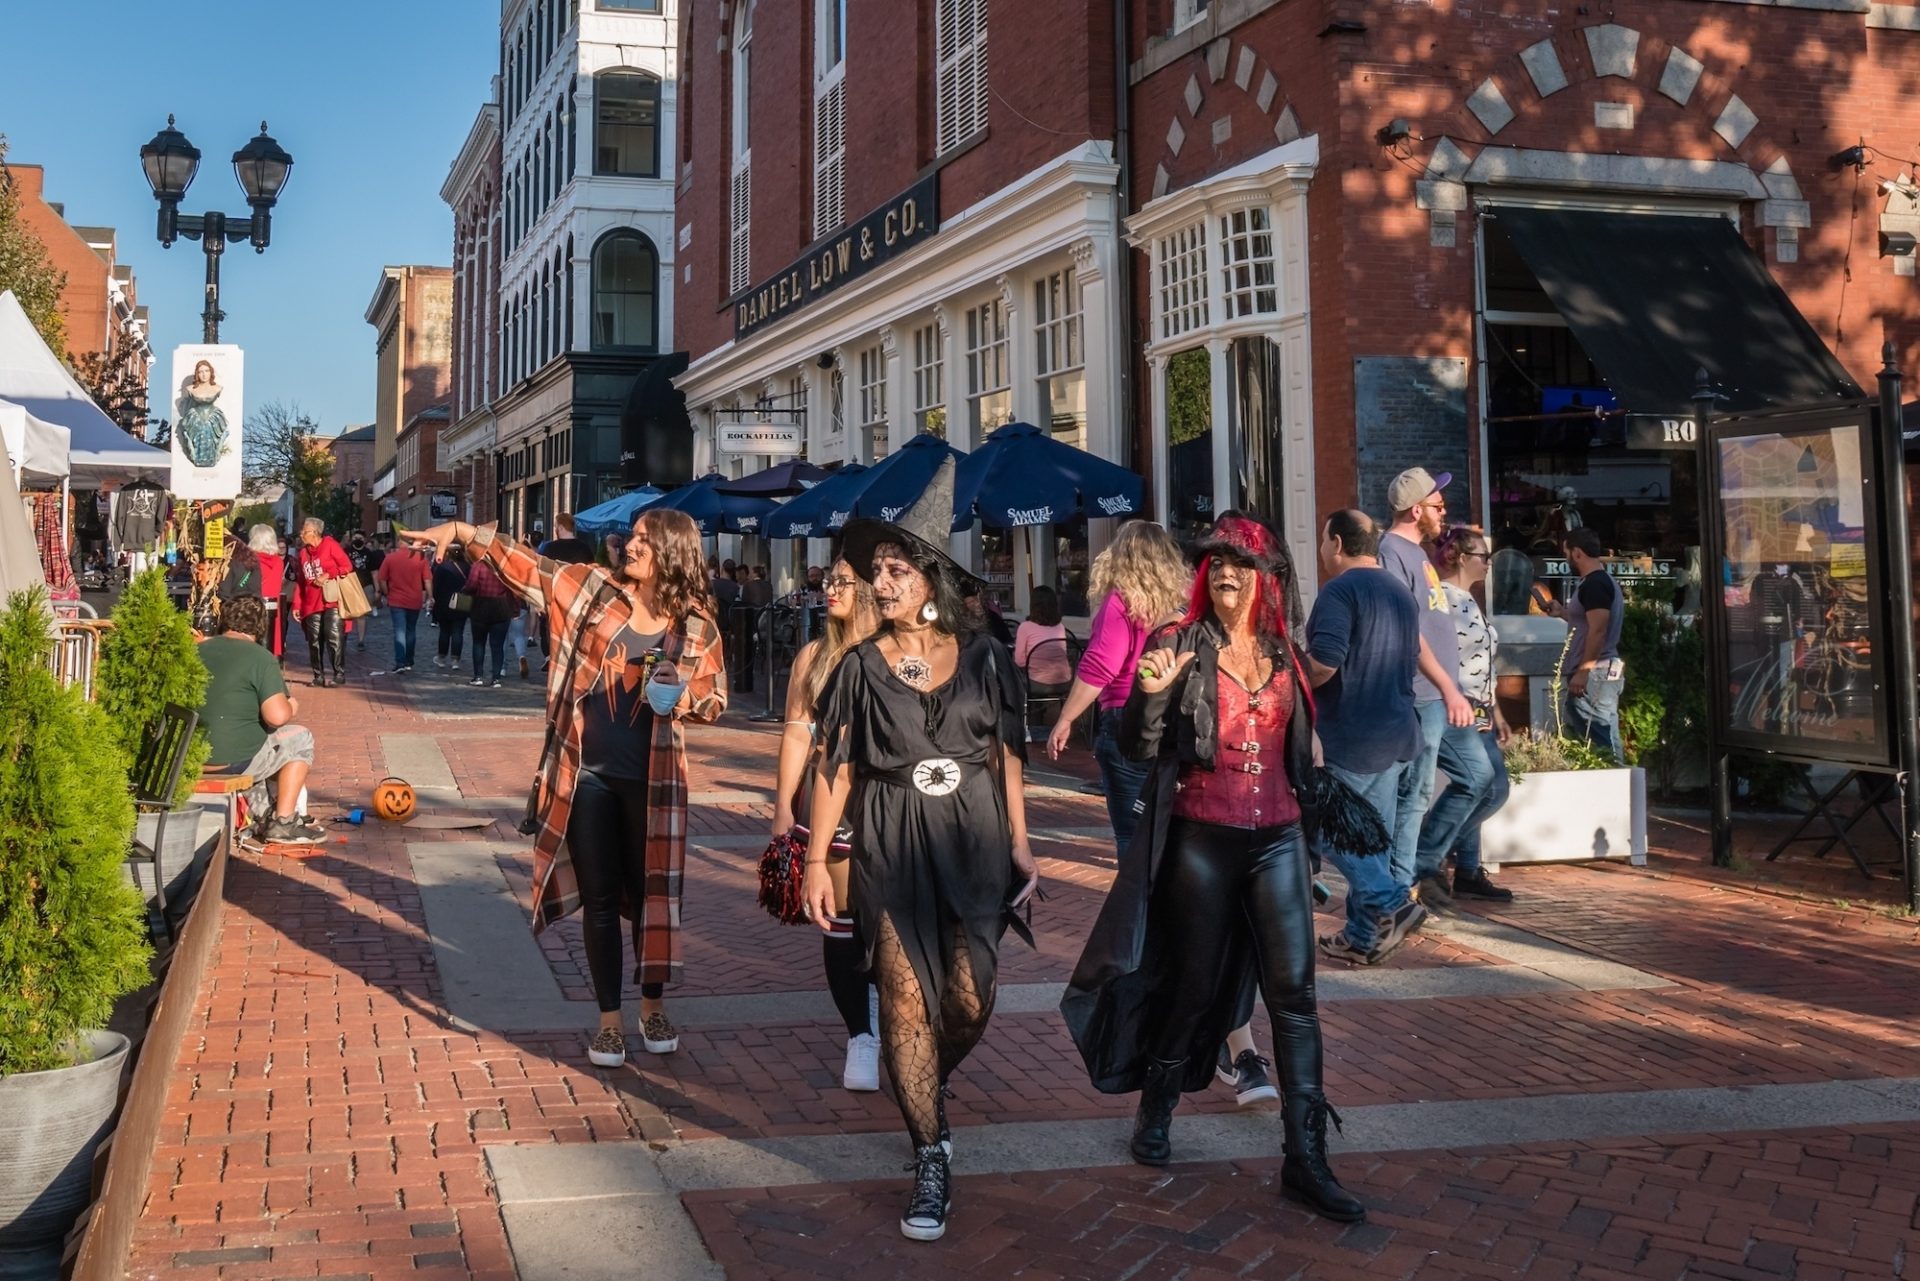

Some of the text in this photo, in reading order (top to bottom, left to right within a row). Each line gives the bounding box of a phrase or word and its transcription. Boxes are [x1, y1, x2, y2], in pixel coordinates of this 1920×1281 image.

[739, 198, 924, 330] DANIEL LOW & CO.
[1097, 494, 1131, 509] SAMUEL
[1007, 506, 1054, 519] SAMUEL
[1012, 515, 1050, 526] ADAMS
